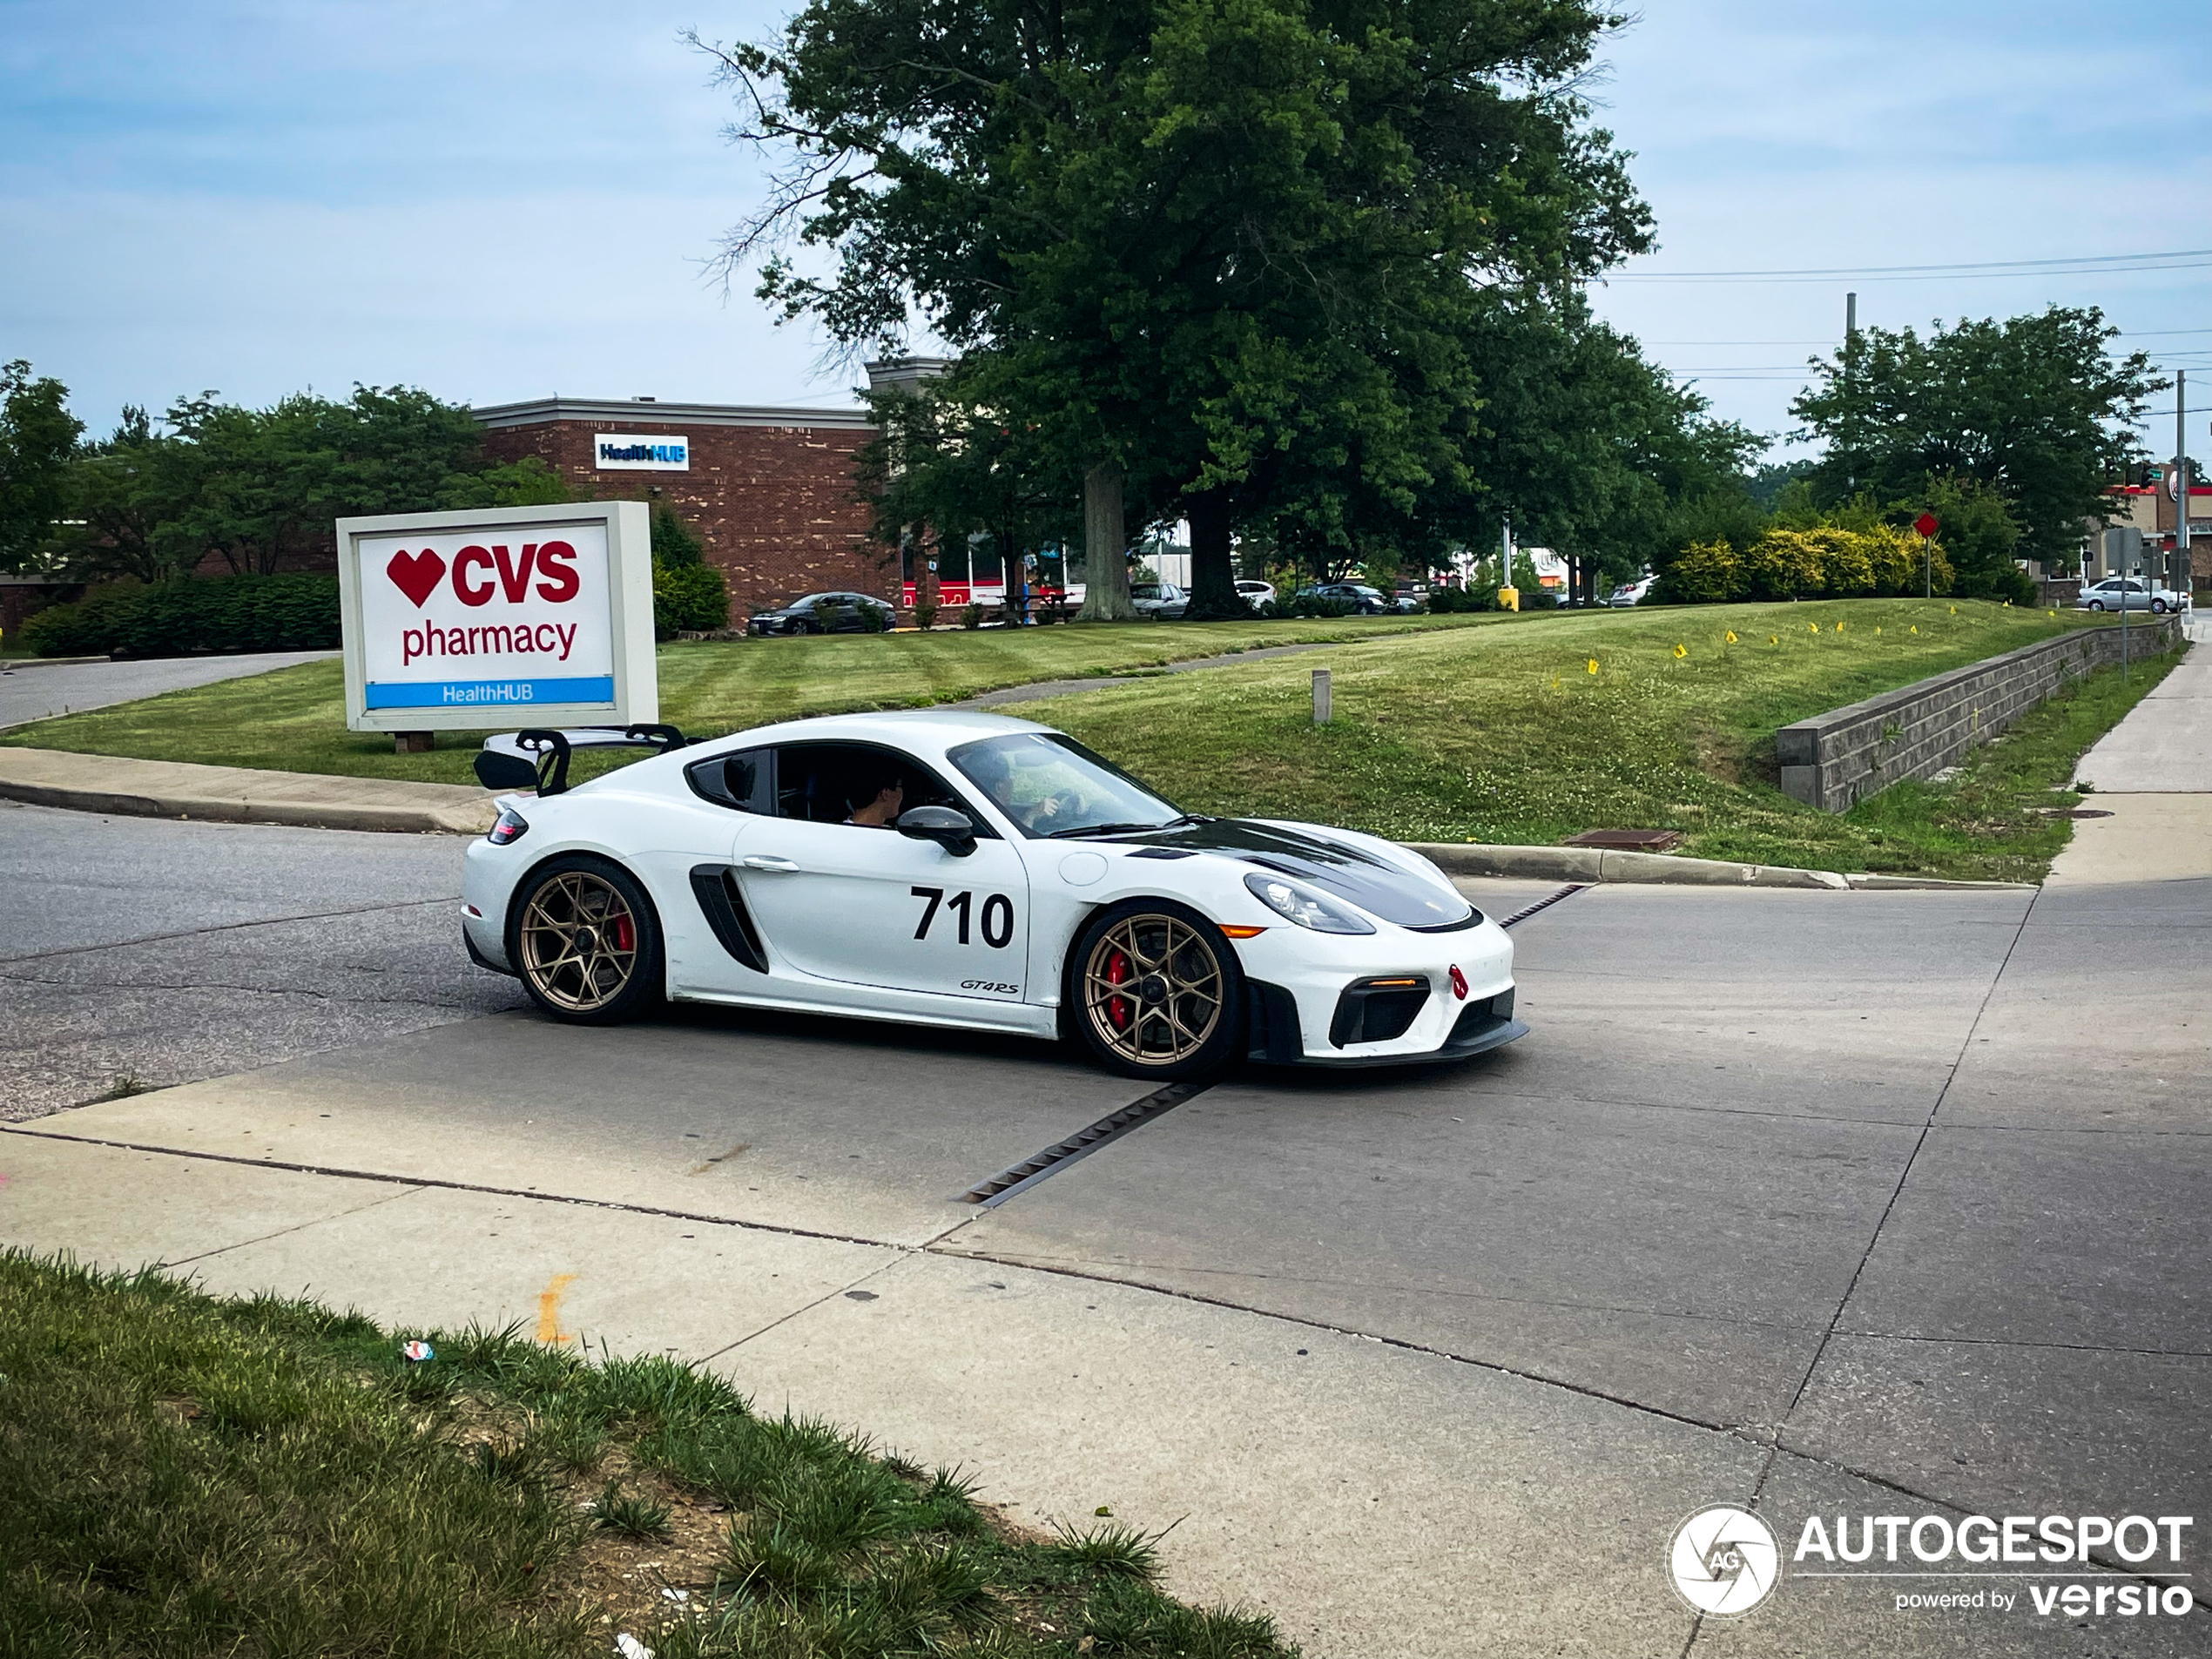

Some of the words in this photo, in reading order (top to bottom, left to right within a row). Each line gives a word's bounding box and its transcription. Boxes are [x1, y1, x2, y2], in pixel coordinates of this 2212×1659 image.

[599, 443, 686, 462] HealthHUB
[451, 540, 580, 607] CVS
[402, 618, 577, 666] pharmacy
[442, 684, 533, 703] HealthHUB
[910, 886, 1015, 949] 710
